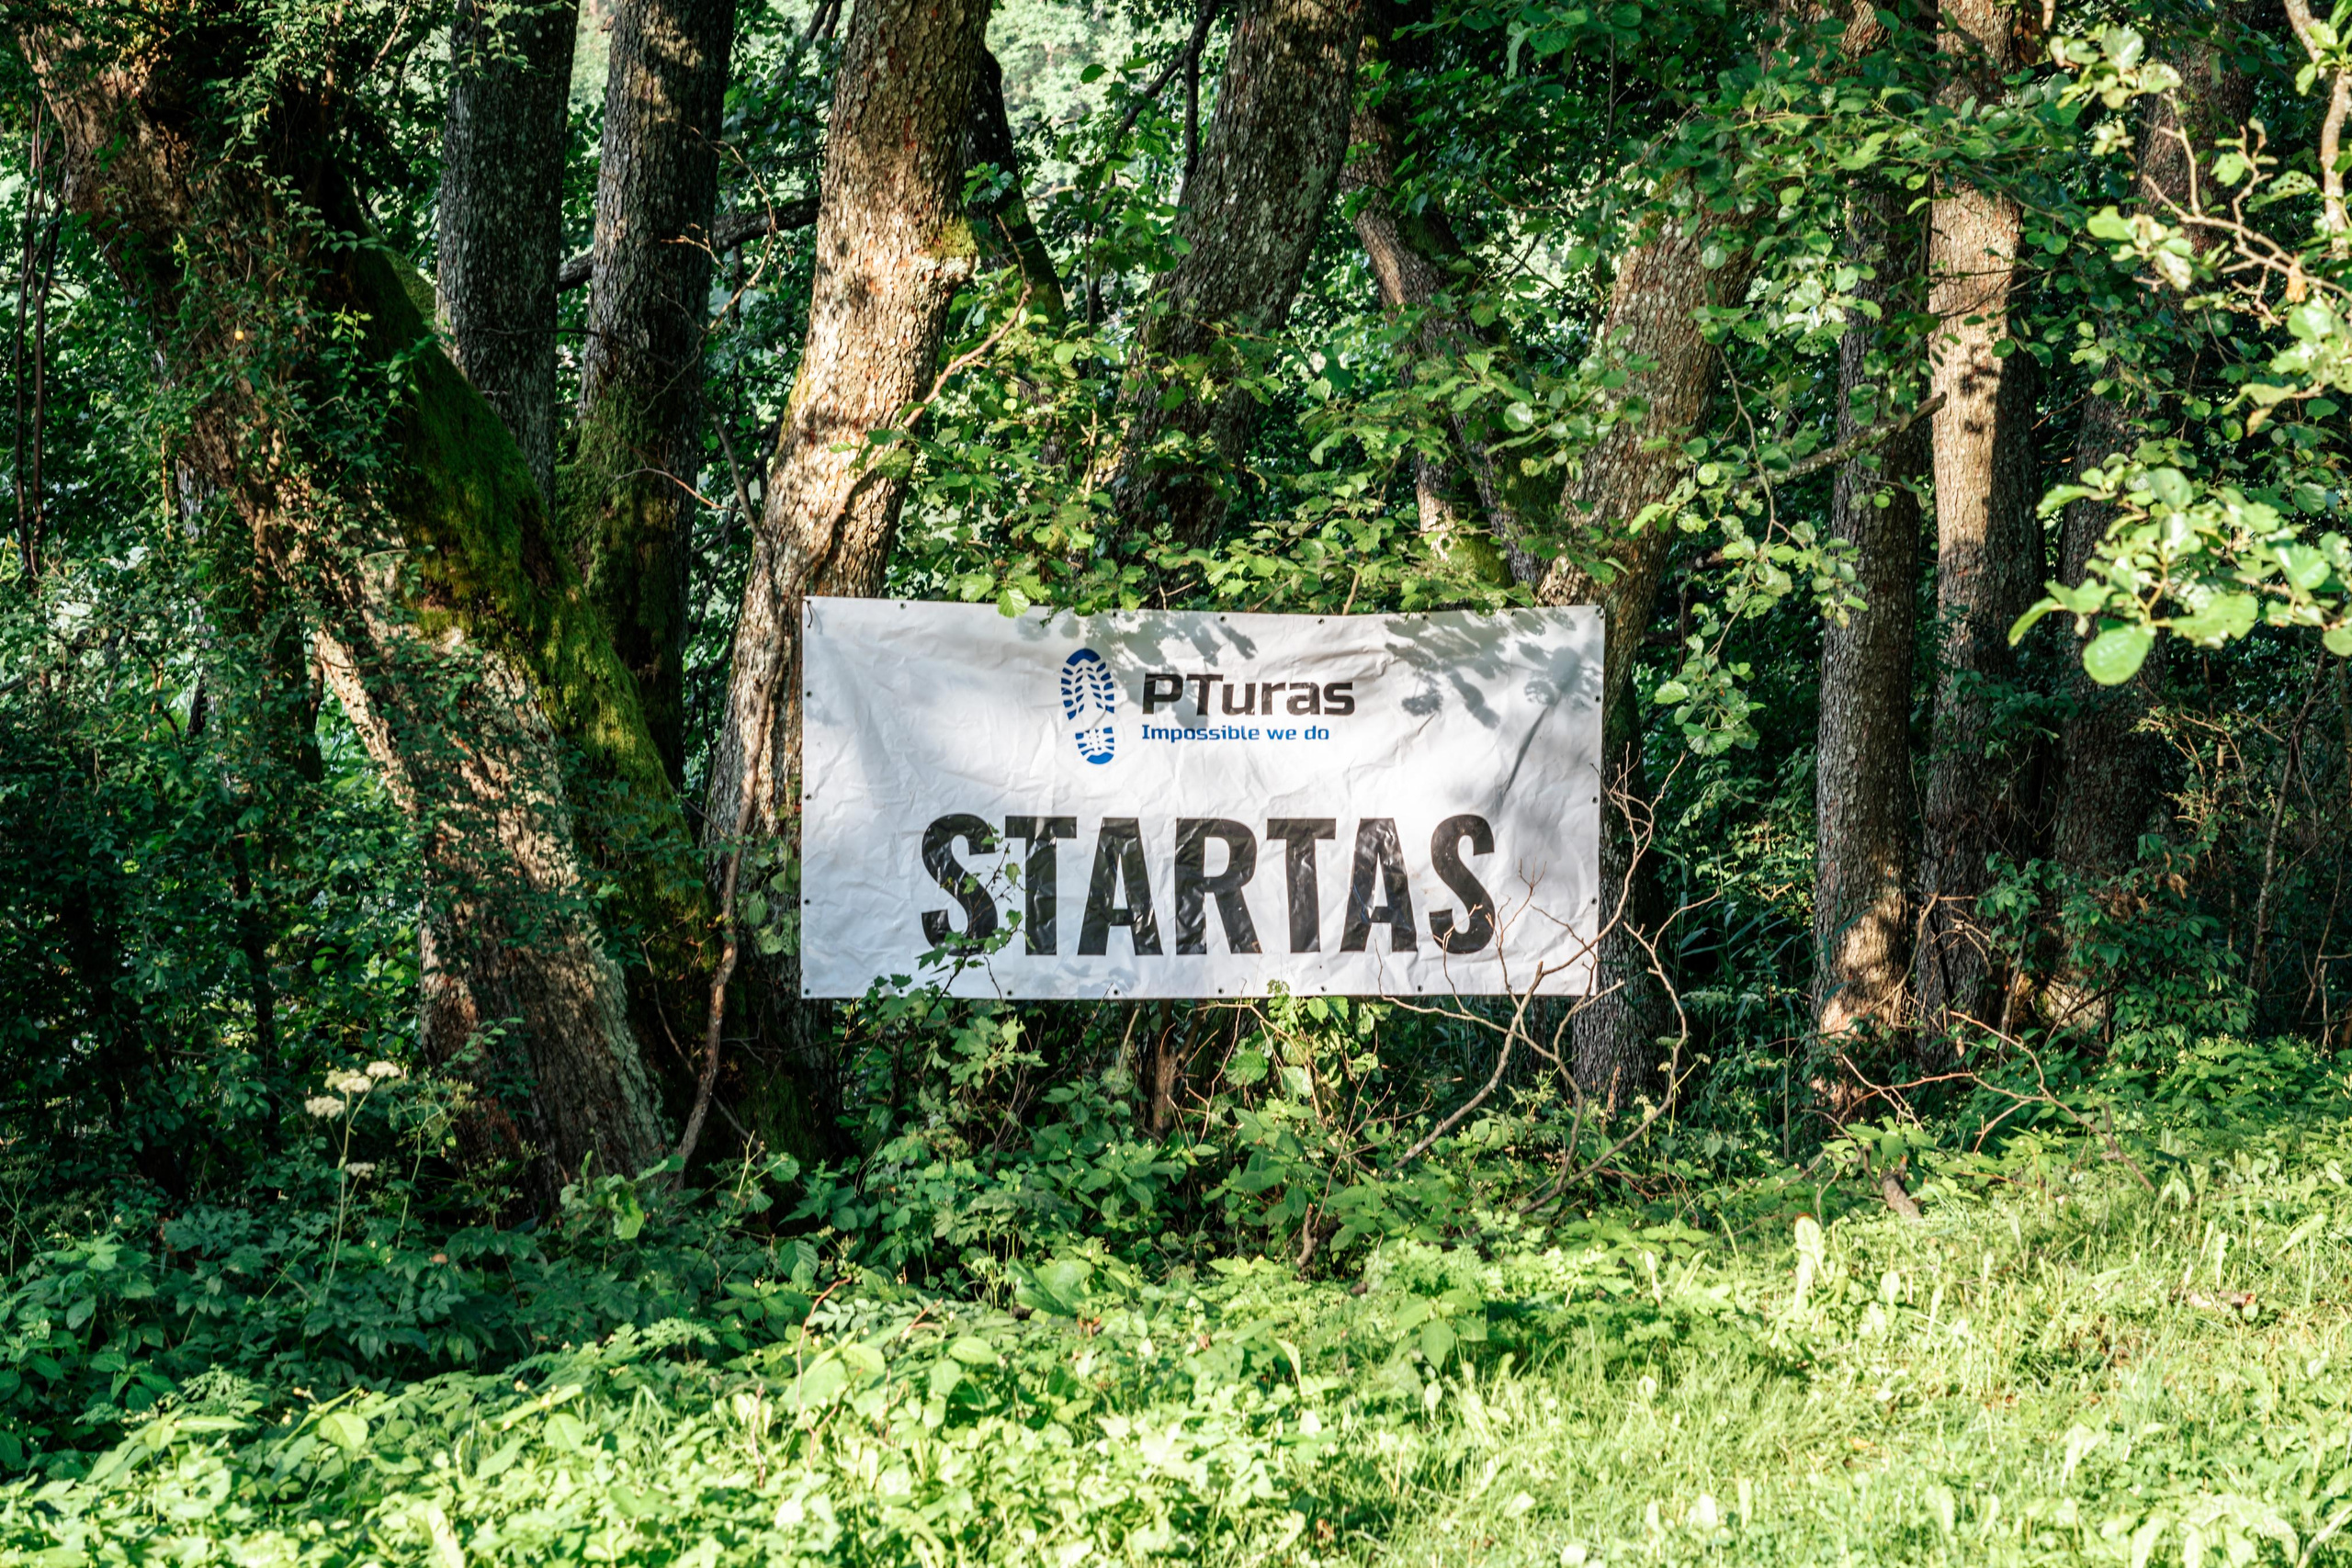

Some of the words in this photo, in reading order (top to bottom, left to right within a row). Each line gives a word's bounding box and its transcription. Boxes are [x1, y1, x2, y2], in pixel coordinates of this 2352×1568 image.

[1142, 672, 1355, 716] PTuras
[1142, 724, 1260, 743] Impossible
[1267, 727, 1296, 740] we
[1305, 725, 1329, 740] do
[921, 813, 1496, 956] STARTAS
